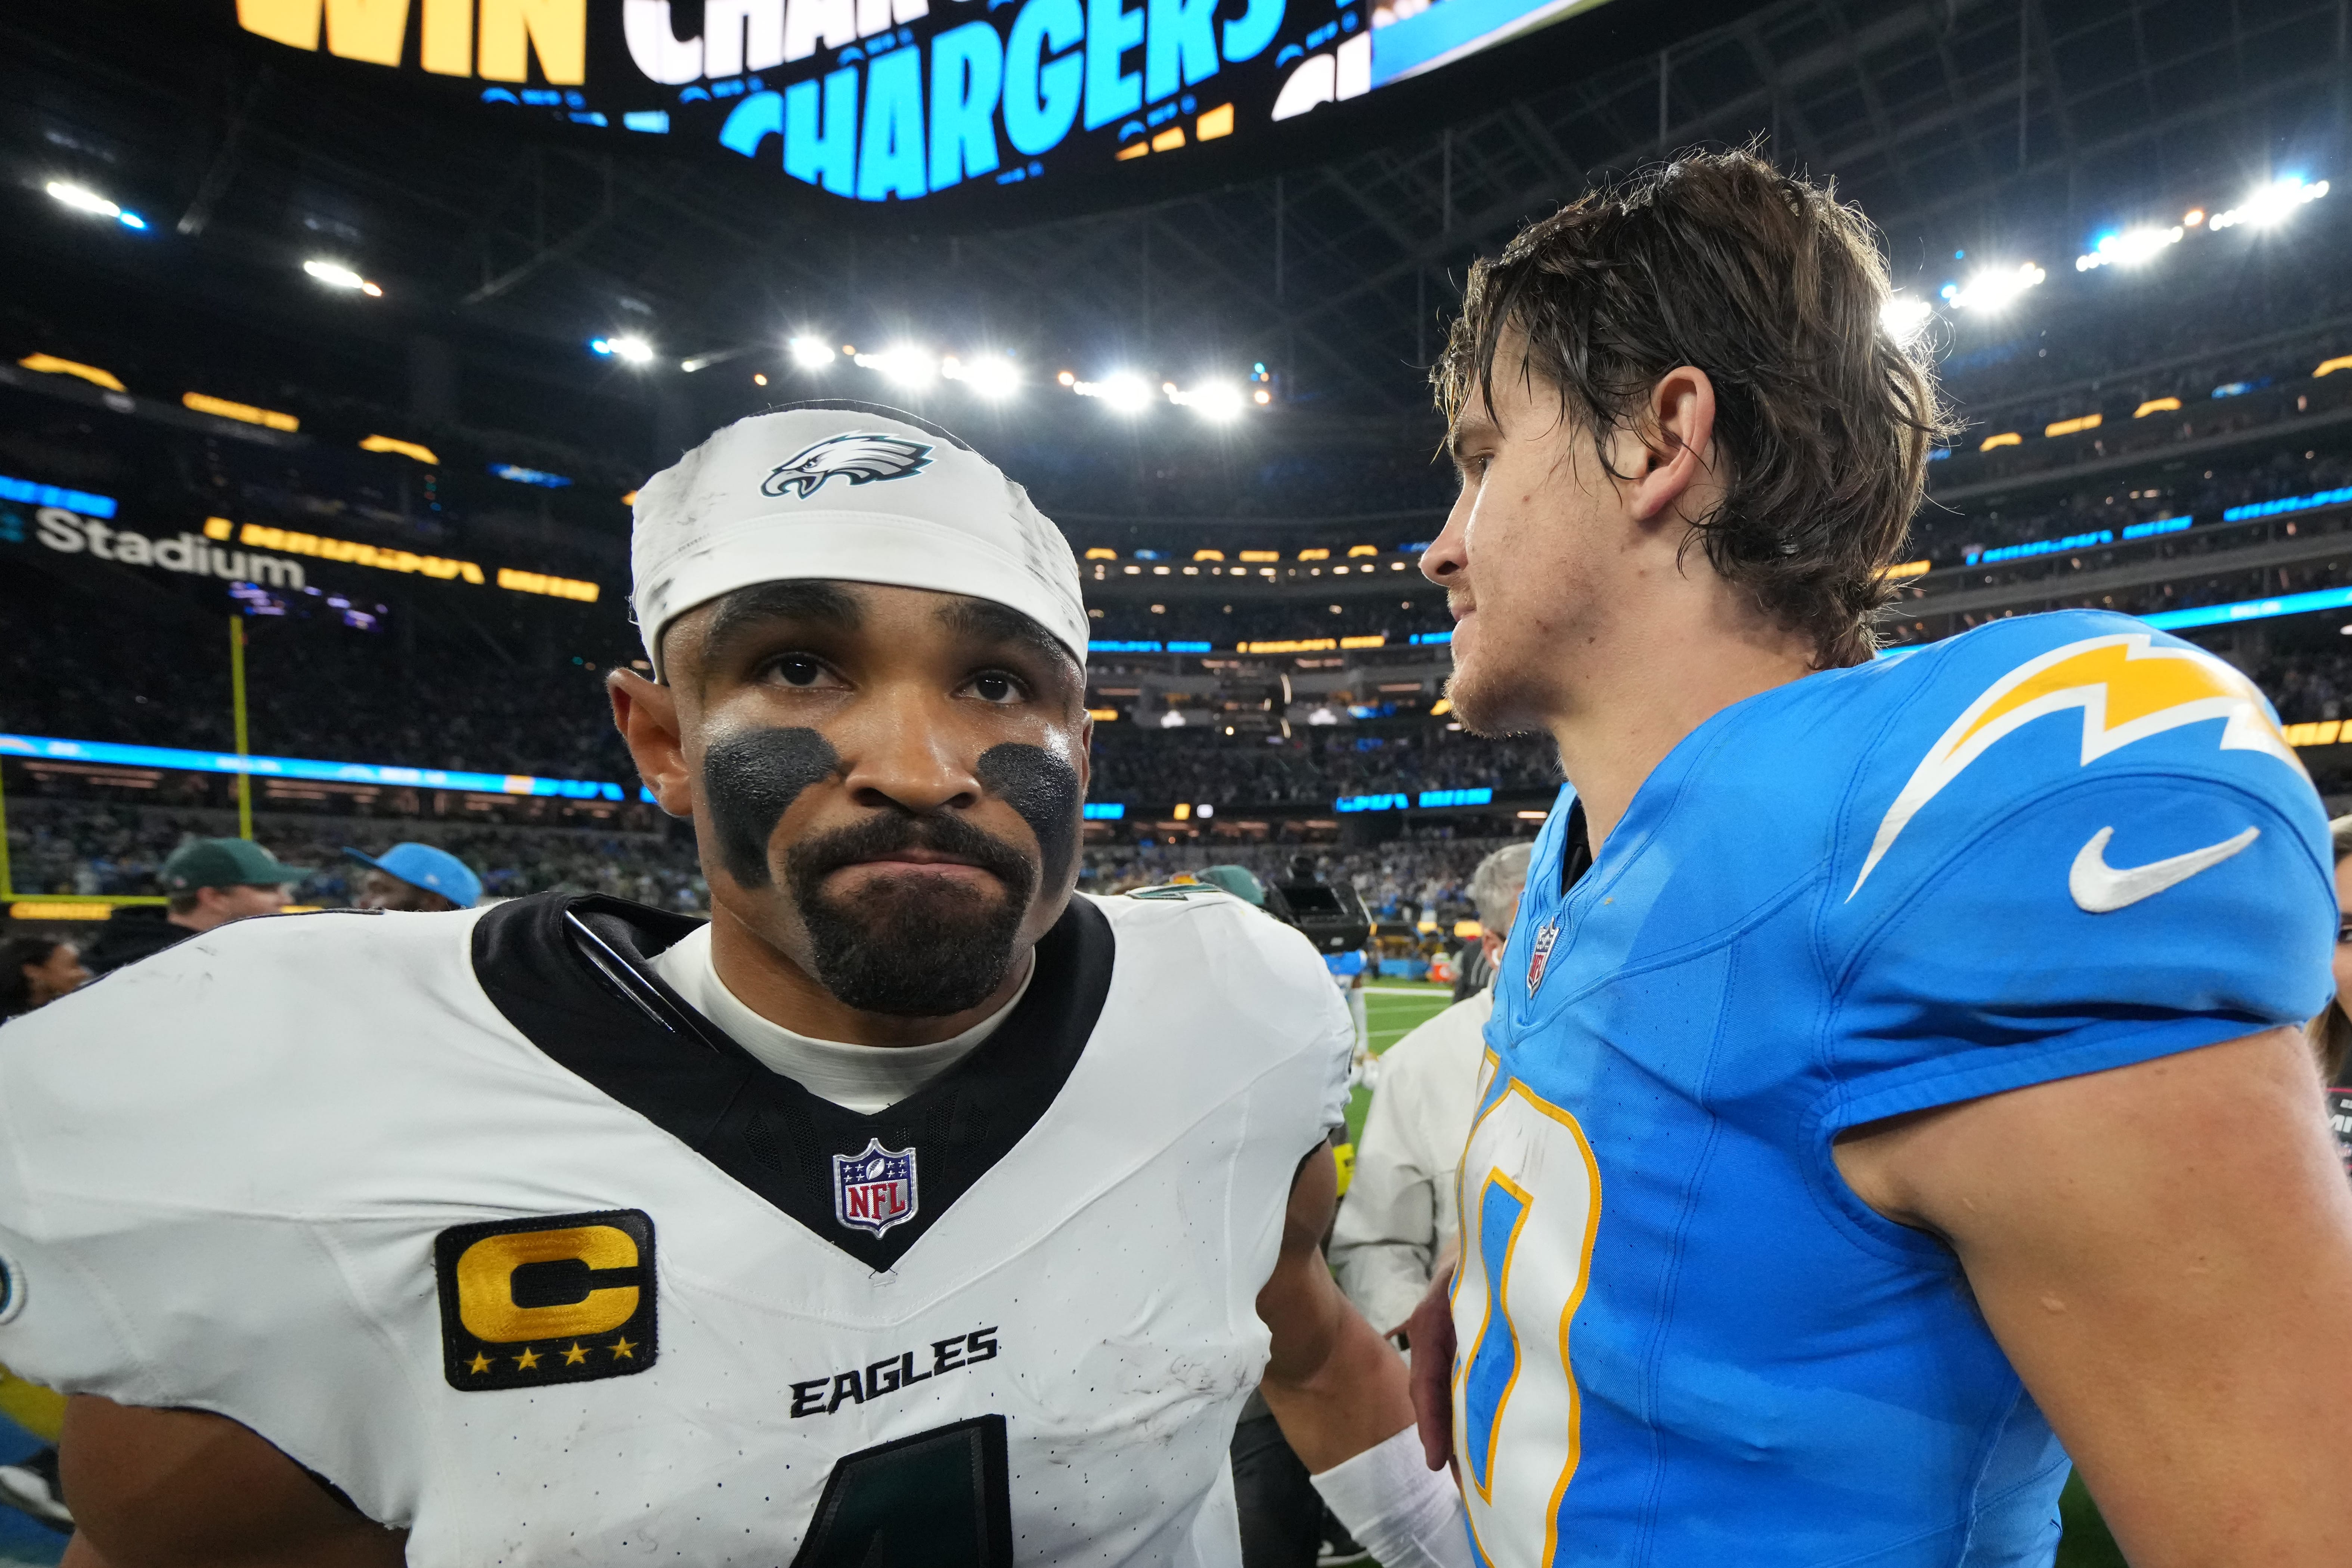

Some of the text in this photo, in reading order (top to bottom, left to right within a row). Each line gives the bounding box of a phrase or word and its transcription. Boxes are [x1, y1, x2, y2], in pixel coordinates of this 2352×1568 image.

[36, 507, 306, 591] Stadium
[848, 1182, 906, 1220] NFL
[456, 1225, 640, 1344] C
[788, 1326, 998, 1419] EAGLES
